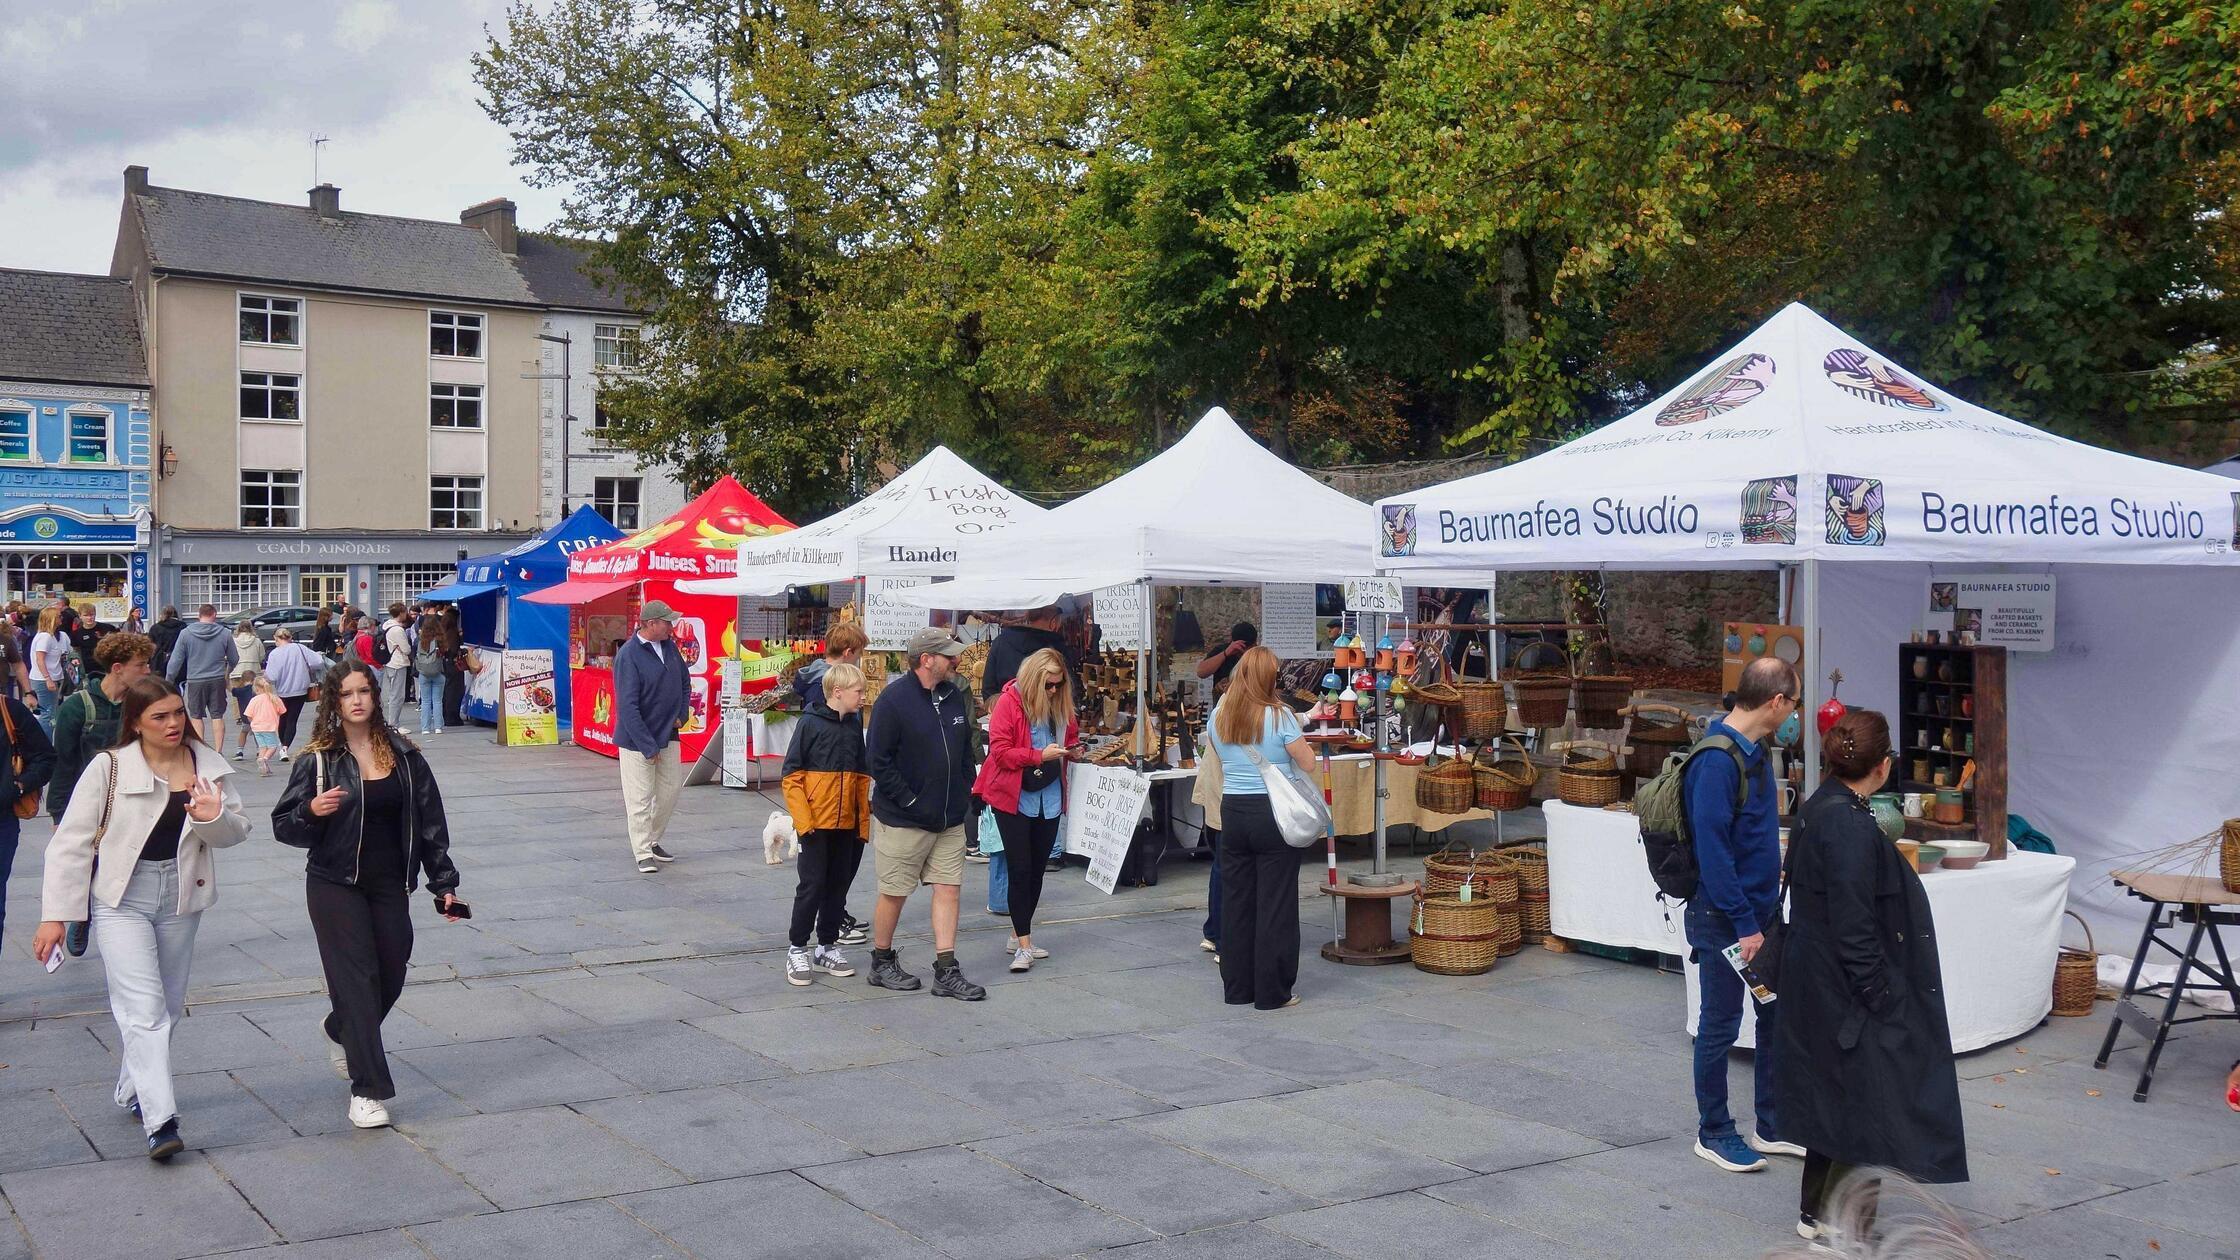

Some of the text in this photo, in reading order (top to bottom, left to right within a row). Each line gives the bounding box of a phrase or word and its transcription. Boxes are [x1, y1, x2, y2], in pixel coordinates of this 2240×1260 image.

[1666, 430, 1694, 442] Co.
[1701, 427, 1782, 440] Kilkenny
[924, 484, 1010, 502] Irish
[947, 502, 1011, 519] Bog
[1922, 491, 2204, 539] Baurnafea Studio
[1439, 495, 1699, 544] Baurnafea Studio
[182, 542, 194, 554] 17
[648, 550, 700, 575] Juices,
[746, 548, 844, 567] Handcrafted in Killkenny
[1358, 580, 1384, 593] for the
[1961, 583, 2050, 592] BAURNAFEA STUDIO
[1096, 599, 1119, 611] BOG
[1360, 592, 1385, 609] birds
[520, 662, 537, 670] Bowl
[743, 666, 761, 676] PH
[506, 672, 552, 688] NOW AVAILABLE
[1086, 791, 1106, 809] BOG
[1115, 794, 1136, 816] IRISH
[1104, 810, 1135, 838] BOG OAK
